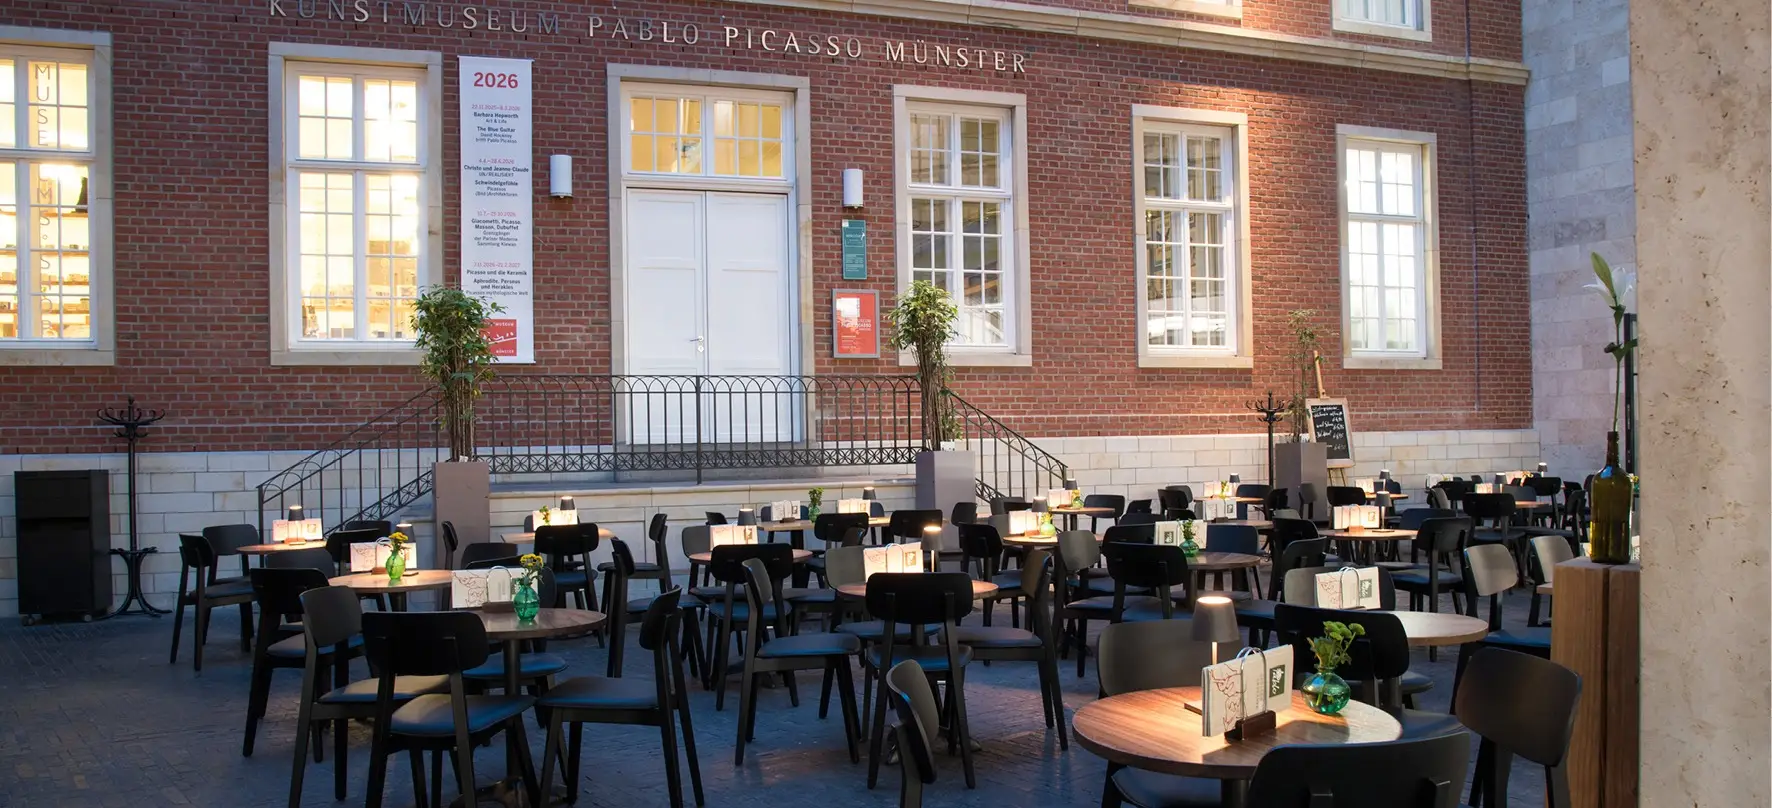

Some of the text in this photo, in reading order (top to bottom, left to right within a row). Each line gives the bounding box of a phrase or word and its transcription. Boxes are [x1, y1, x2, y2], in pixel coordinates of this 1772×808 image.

[269, 0, 1026, 73] KUNSTMUSEUM PABLO PICASSO MÜNSTER
[473, 71, 519, 89] 2026
